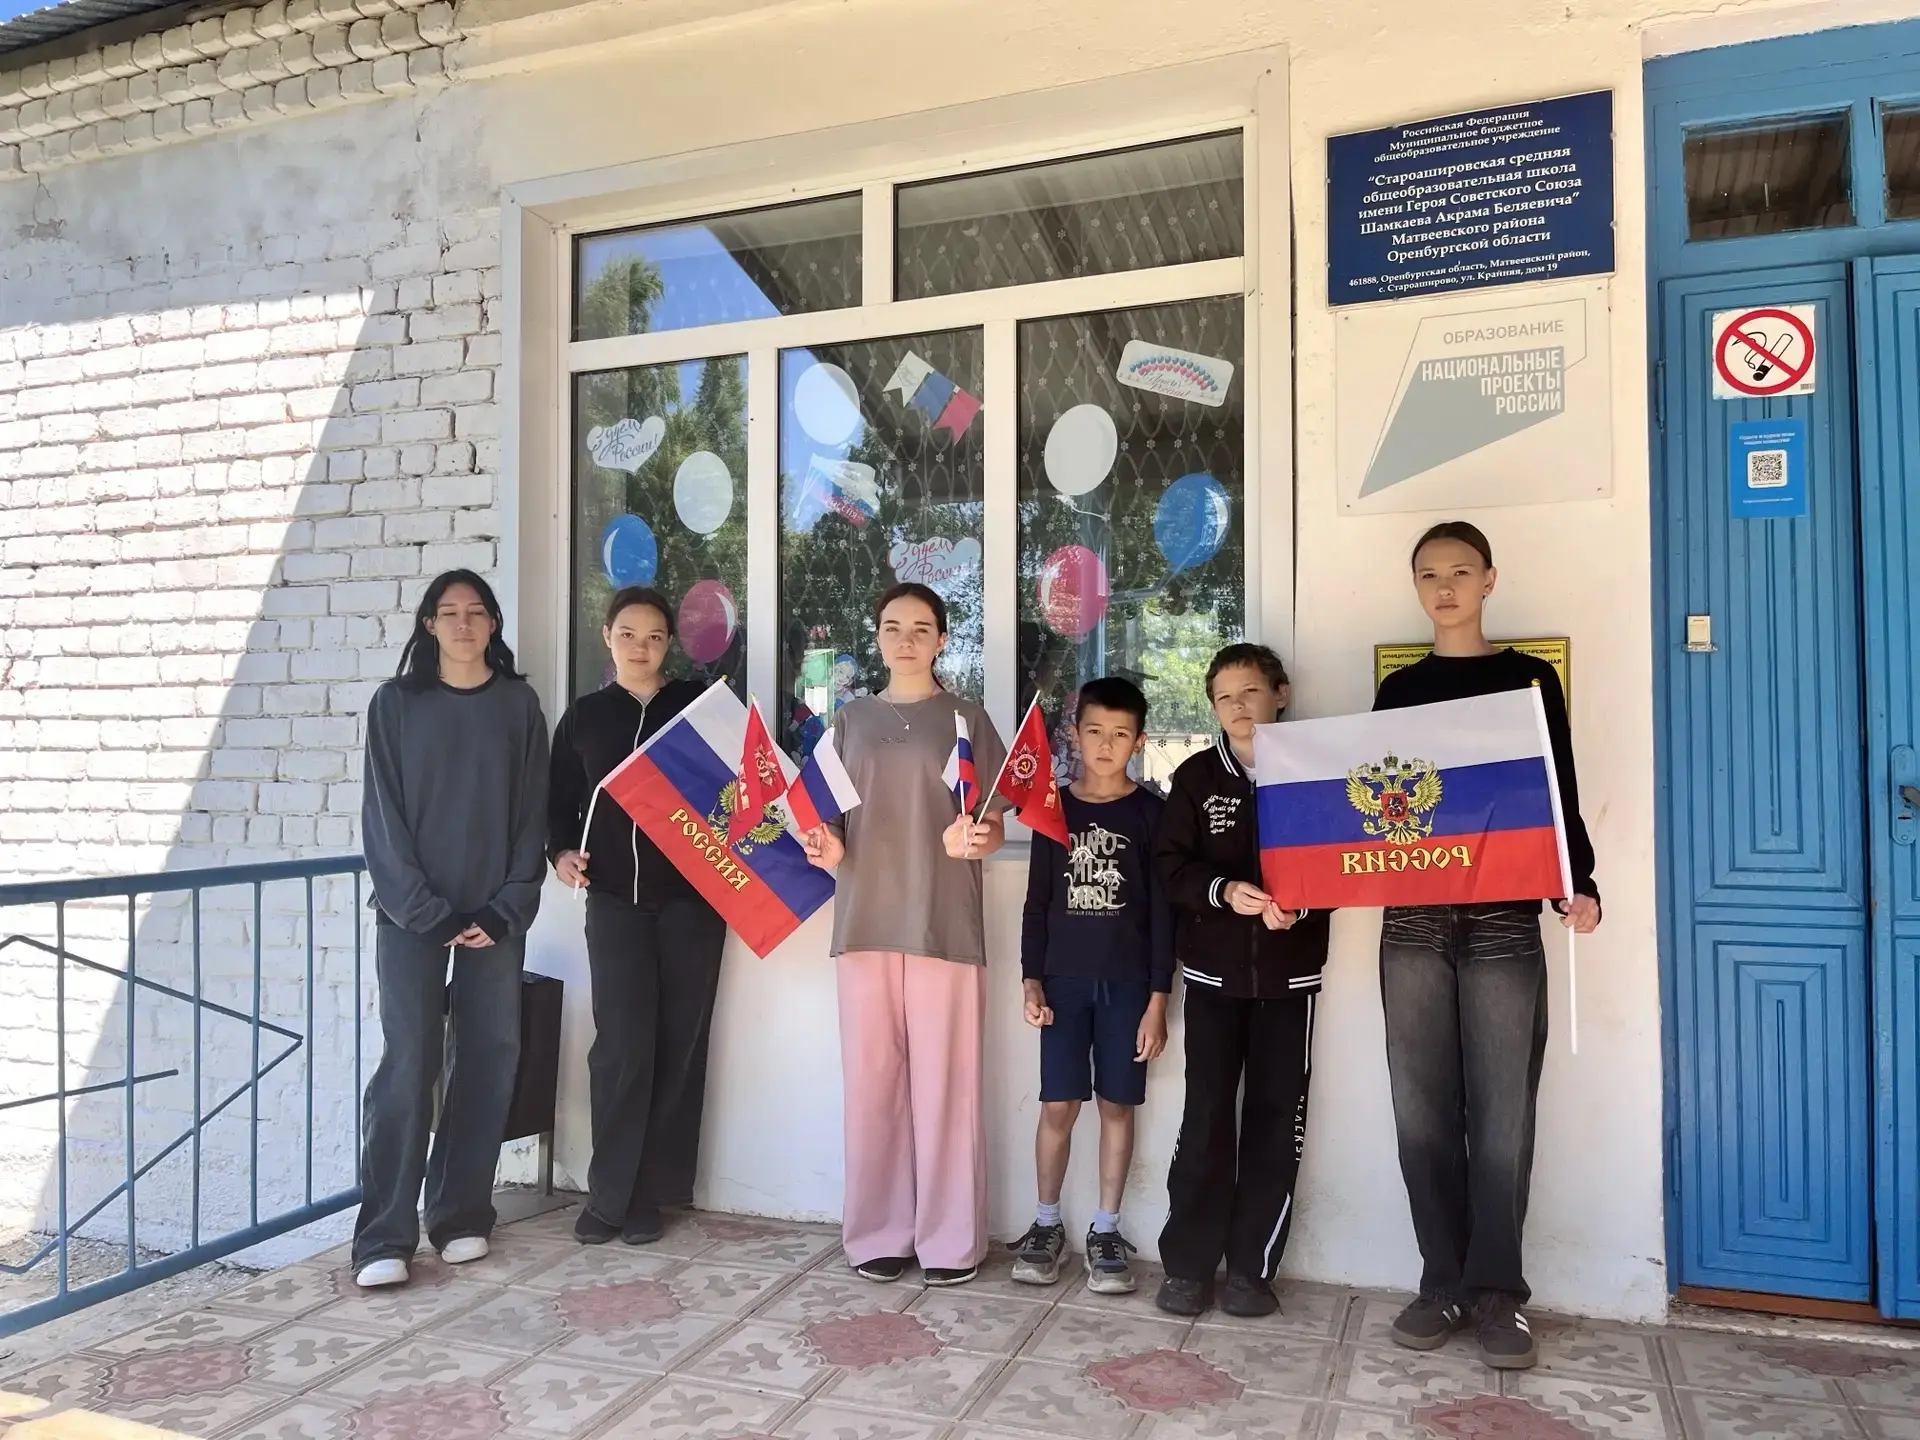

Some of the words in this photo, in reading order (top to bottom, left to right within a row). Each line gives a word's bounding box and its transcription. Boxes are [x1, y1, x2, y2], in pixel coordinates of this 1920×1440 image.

[1389, 129, 1478, 151] Муниципальное
[1480, 119, 1544, 135] бюджетное
[1402, 121, 1463, 139] Российская
[1466, 110, 1530, 127] Федерация
[1373, 137, 1490, 163] общеобразовательное
[1491, 126, 1561, 145] учреждение
[1509, 147, 1571, 166] средняя
[1358, 204, 1403, 219] имени
[1406, 197, 1447, 213] Героя
[1450, 185, 1531, 205] Советского
[1534, 178, 1582, 192] Союза
[1363, 170, 1522, 204] общеобразовательная
[1526, 163, 1577, 179] школа
[1360, 216, 1432, 235] Шамкаева
[1435, 207, 1490, 224] Акрама
[1391, 224, 1489, 246] Матвеевского
[1493, 215, 1545, 234] района
[1387, 238, 1489, 264] Оренбургской
[1492, 231, 1551, 247] области
[1348, 276, 1379, 287] 461888,
[1380, 268, 1446, 284] Оренбургская
[1448, 262, 1488, 274] область,
[1490, 251, 1555, 268] Матвеевский
[1557, 249, 1591, 262] район,
[1387, 276, 1459, 292] Староаширово,
[1460, 274, 1475, 284] ул.
[1477, 267, 1524, 281] Крайняя,
[1525, 266, 1545, 275] дом
[1547, 263, 1558, 271] 19
[1443, 319, 1564, 345] ОБРАЗОВАНИЕ
[1421, 349, 1562, 382] НАЦИОНАЛЬНЫЕ
[1480, 370, 1561, 396] ПРОЕКТЫ
[1495, 391, 1562, 415] РОССИИ
[668, 808, 752, 893] РОССИЯ
